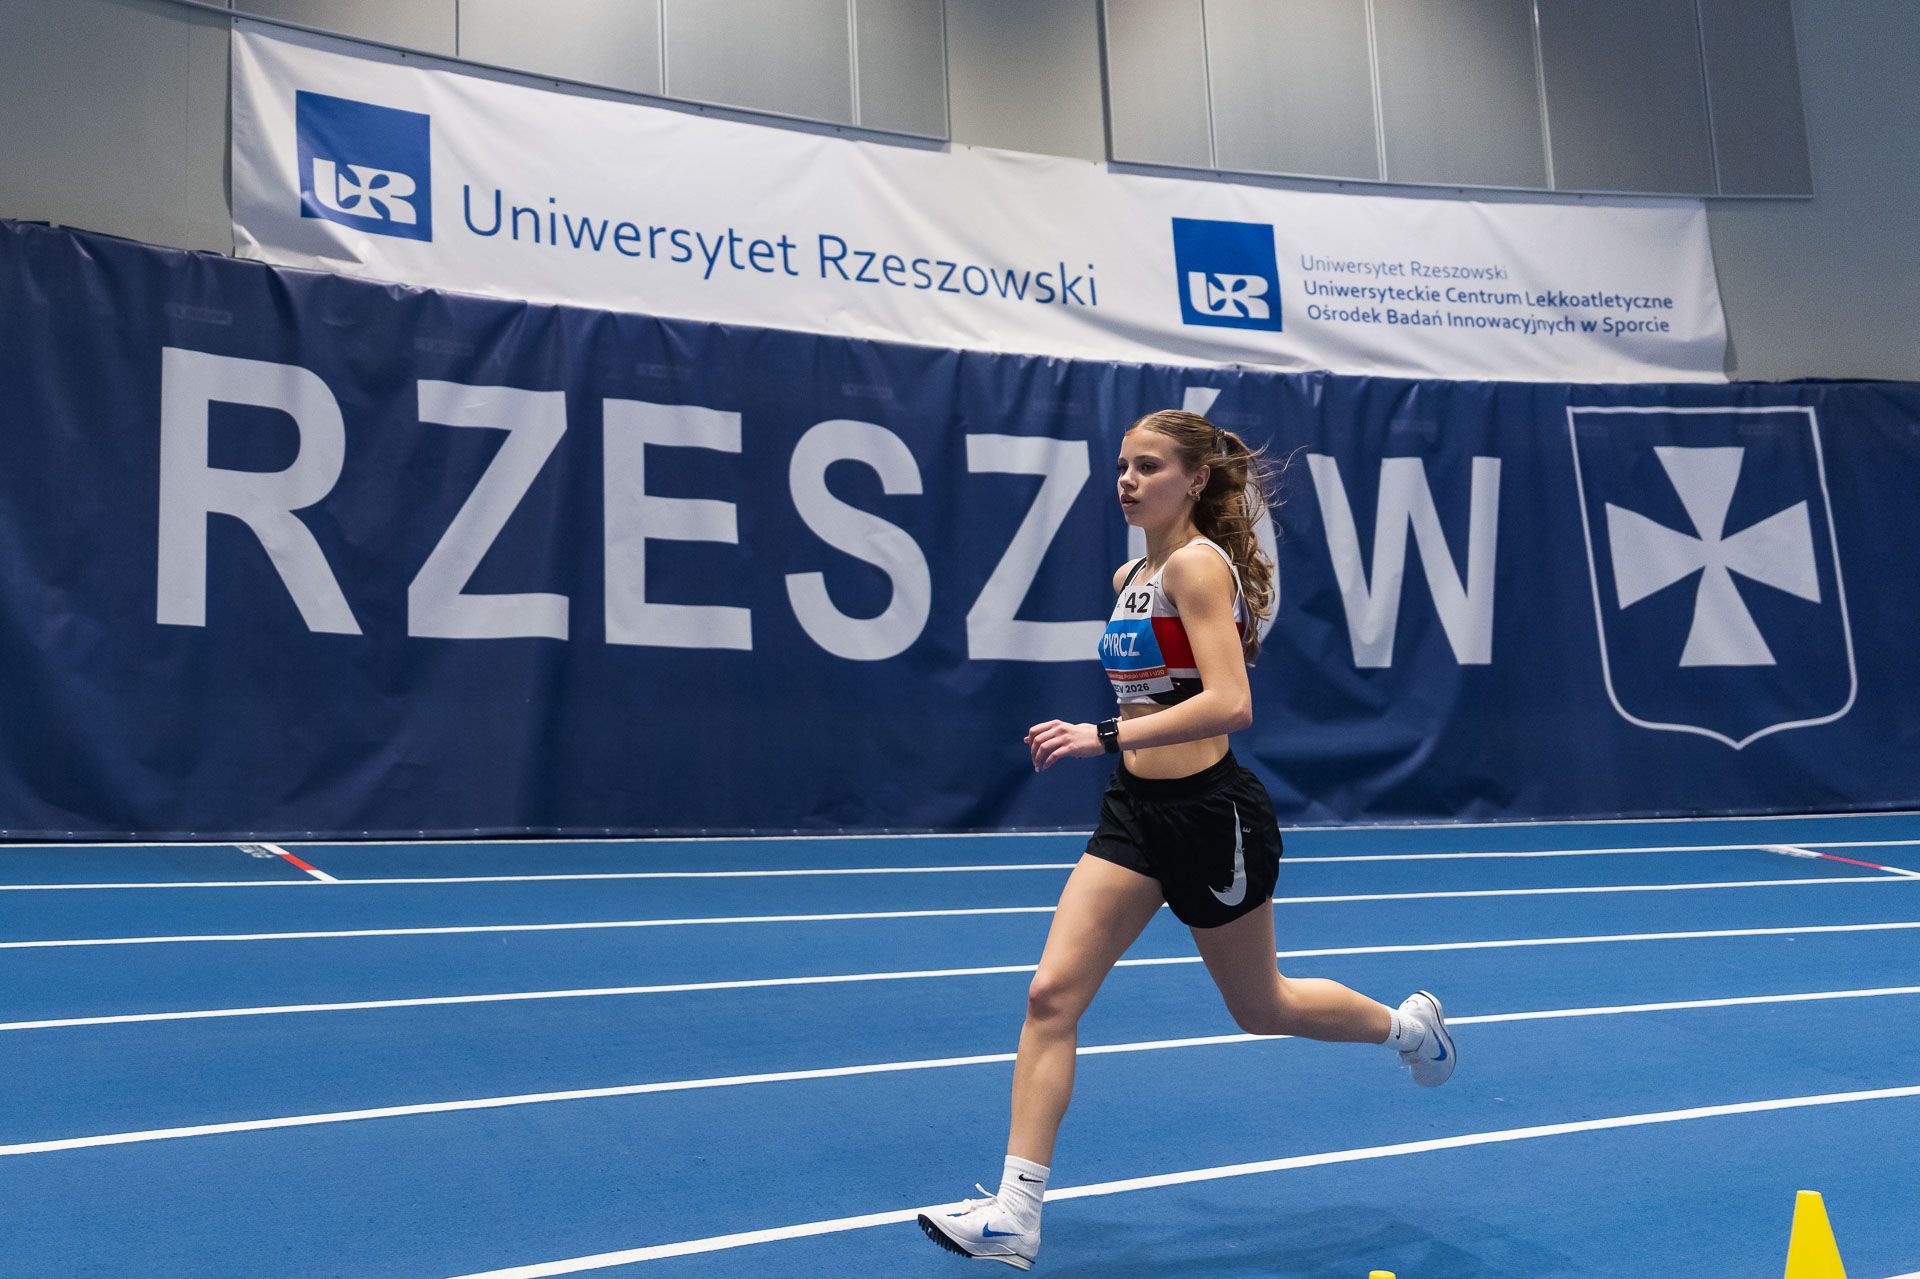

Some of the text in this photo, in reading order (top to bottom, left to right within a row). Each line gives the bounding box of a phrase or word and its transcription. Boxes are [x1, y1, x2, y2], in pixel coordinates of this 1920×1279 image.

[463, 184, 1098, 307] Uniwersytet Rzeszowski
[1301, 254, 1508, 281] Uniwersytet Rzeszowski
[1303, 279, 1673, 313] Uniwersyteckie Centrum Lekkoatletyczne
[1307, 304, 1671, 337] Ośrodek Badań Innowacyjnych w Sporcie
[1103, 632, 1141, 657] PYRCZ
[1125, 682, 1150, 694] 2026
